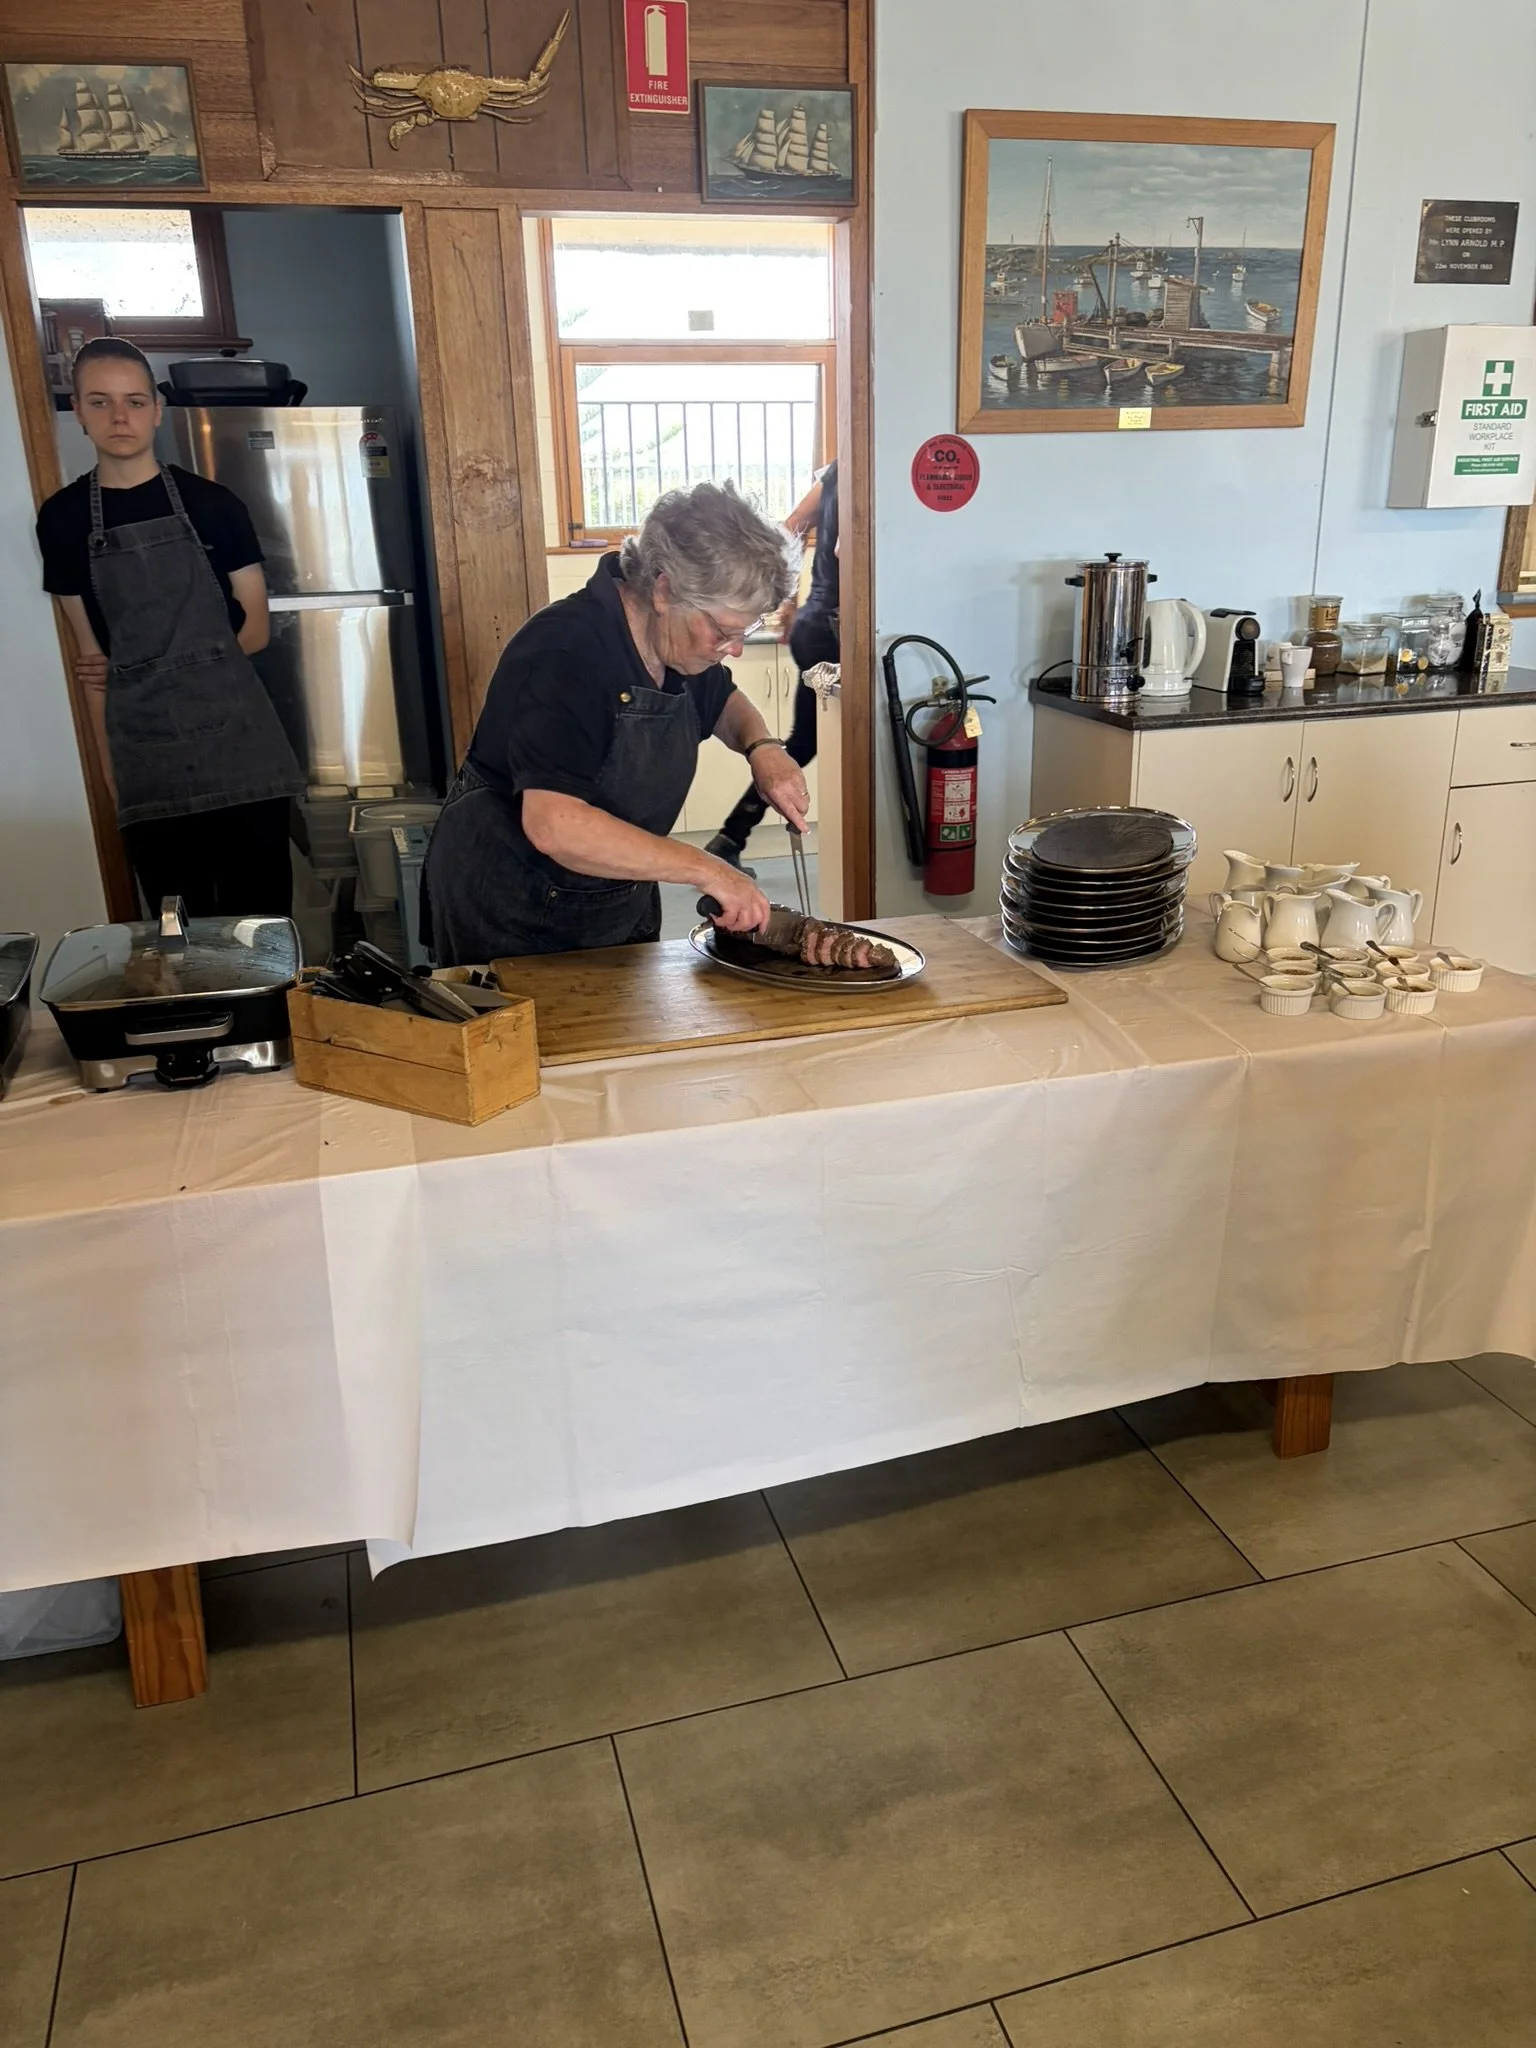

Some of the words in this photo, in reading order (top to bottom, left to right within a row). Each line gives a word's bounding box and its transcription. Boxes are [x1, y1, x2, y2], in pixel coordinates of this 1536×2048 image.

[648, 80, 669, 90] FIRE
[630, 93, 688, 105] EXTINGUISHER
[1441, 239, 1459, 247] LYNN
[1460, 239, 1488, 247] ARNOLD
[1465, 403, 1499, 416] FIRST
[1500, 403, 1523, 416] AID
[1473, 422, 1512, 431] STANDARD
[1469, 432, 1514, 441] WORKPLACE
[1483, 442, 1496, 450] KIT
